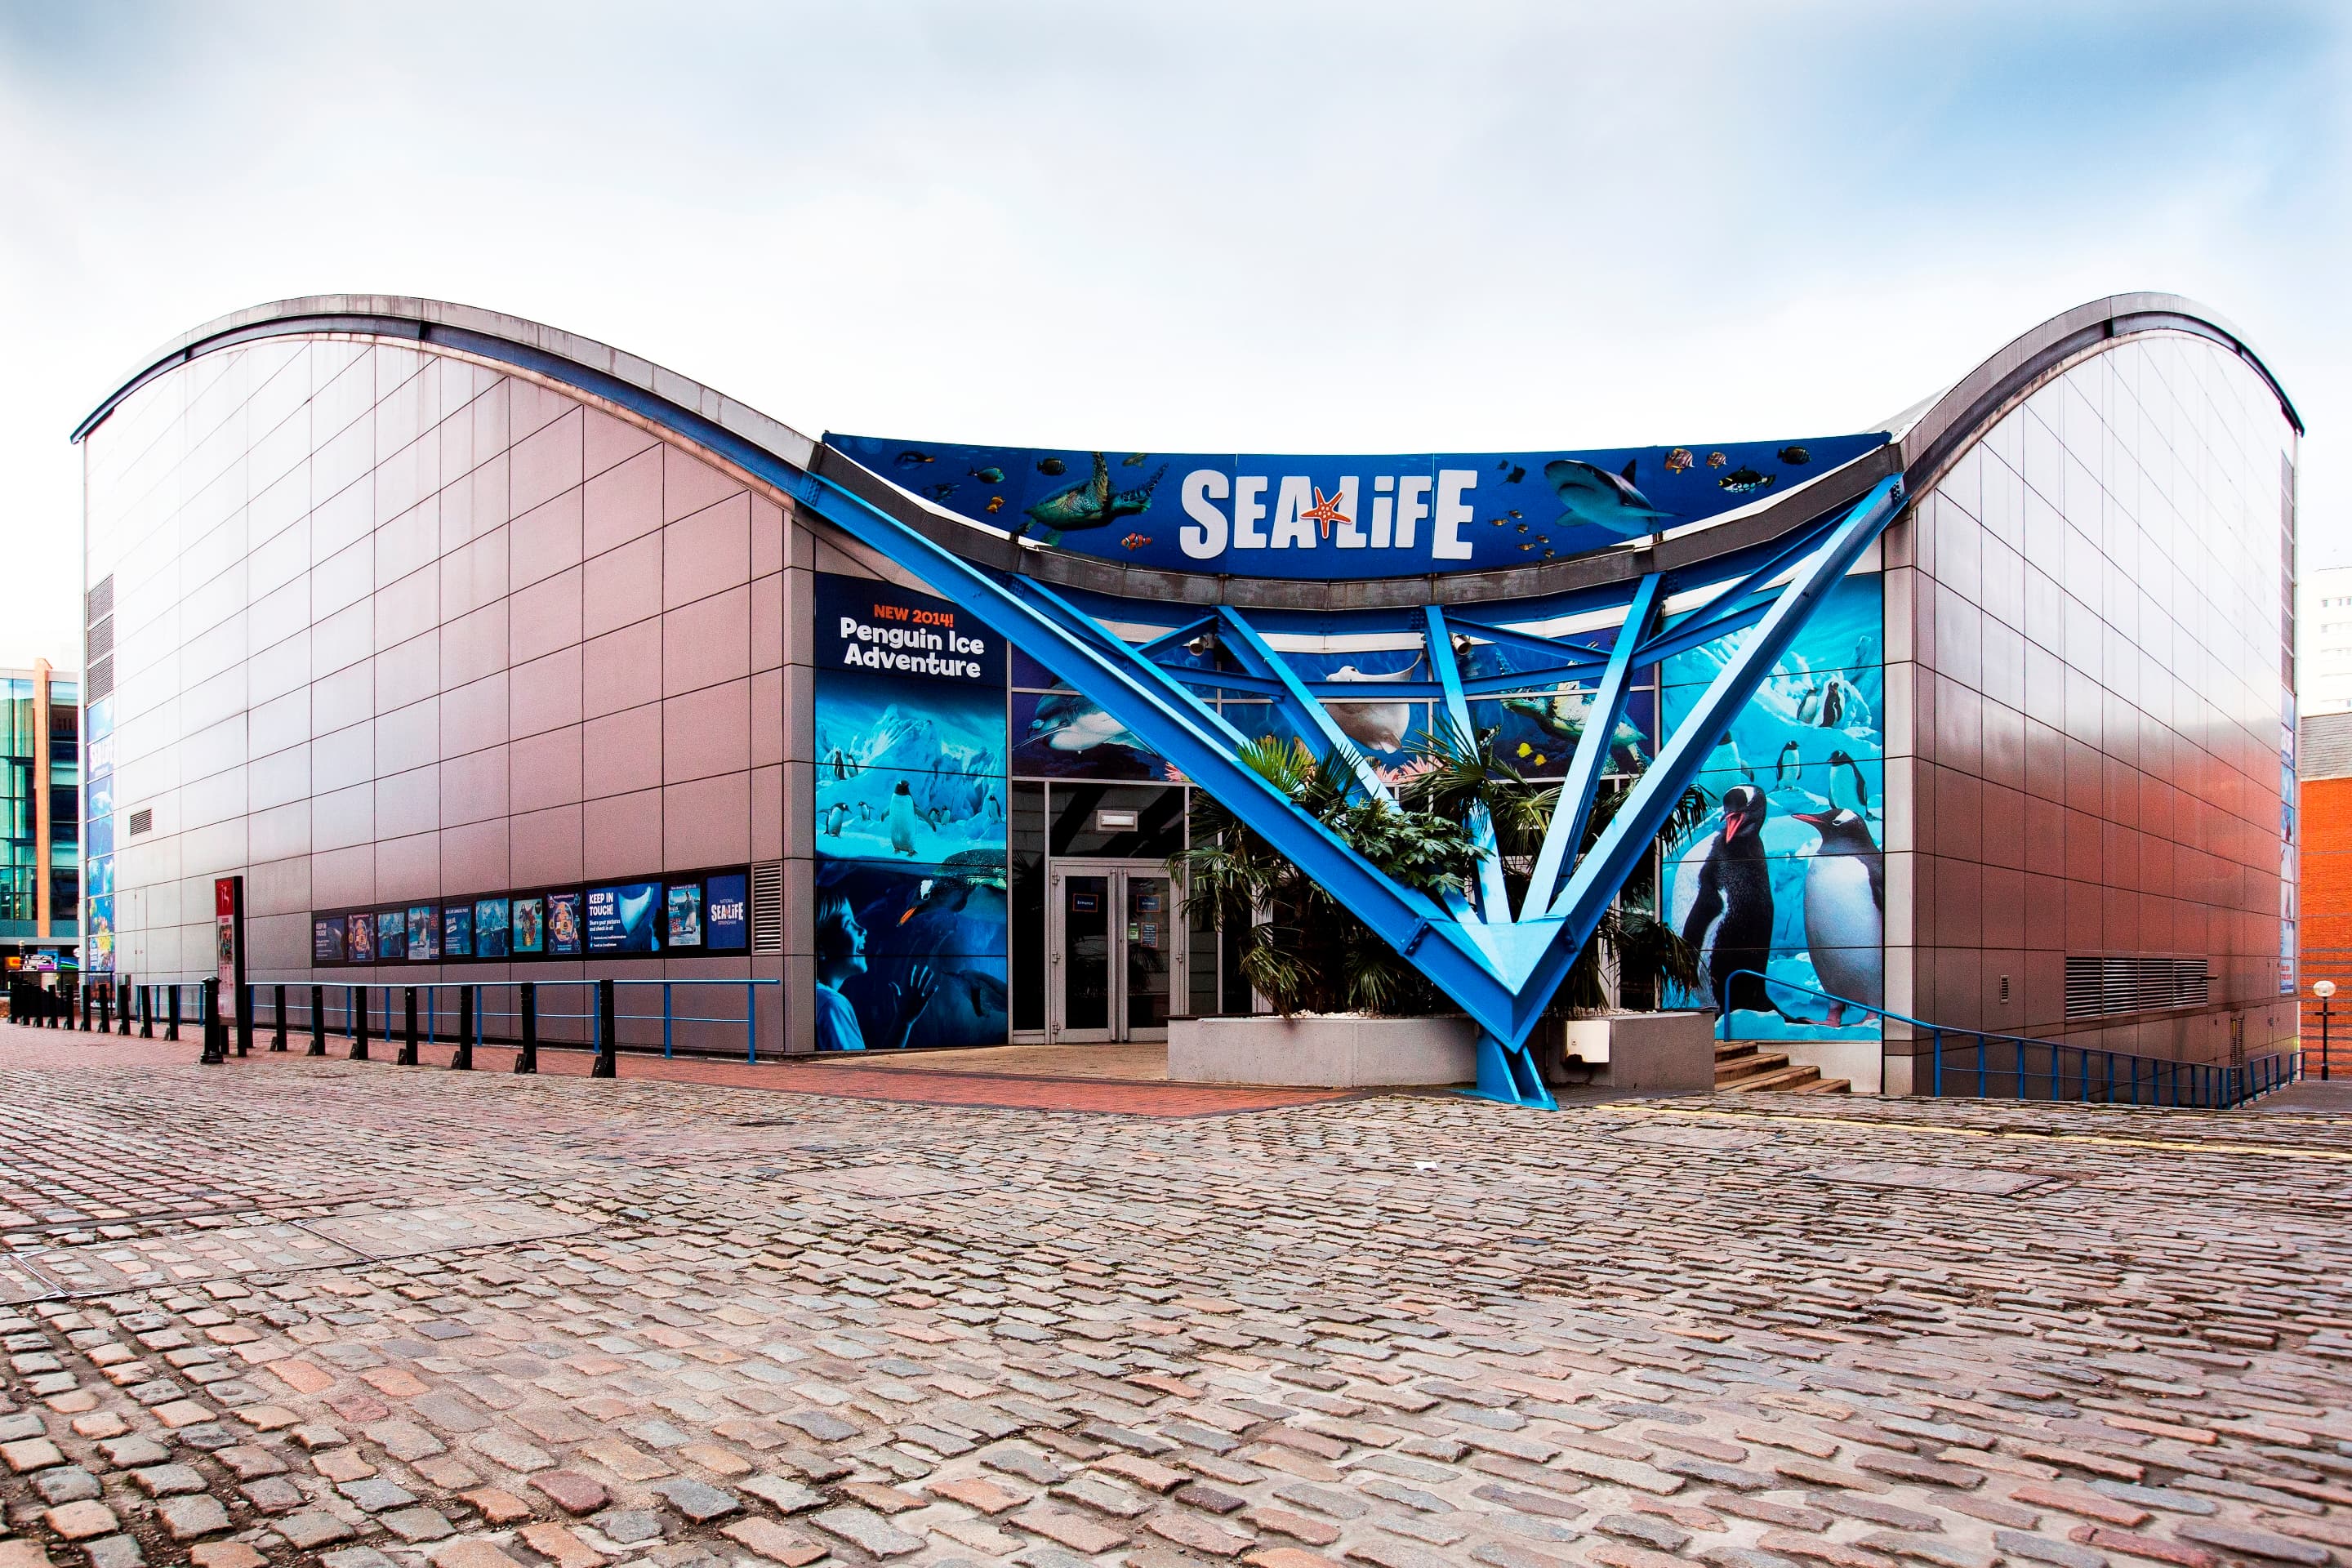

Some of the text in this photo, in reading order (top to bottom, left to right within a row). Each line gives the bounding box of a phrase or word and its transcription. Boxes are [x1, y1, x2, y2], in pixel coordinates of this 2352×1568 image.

[1179, 469, 1317, 559] SEA
[874, 604, 954, 628] NEW 2014!
[840, 617, 985, 655] Penguin Ice
[844, 643, 981, 678] Adventure
[589, 892, 613, 904] KEEP IN
[589, 903, 613, 916] TOUCH!
[710, 904, 726, 922] SEA
